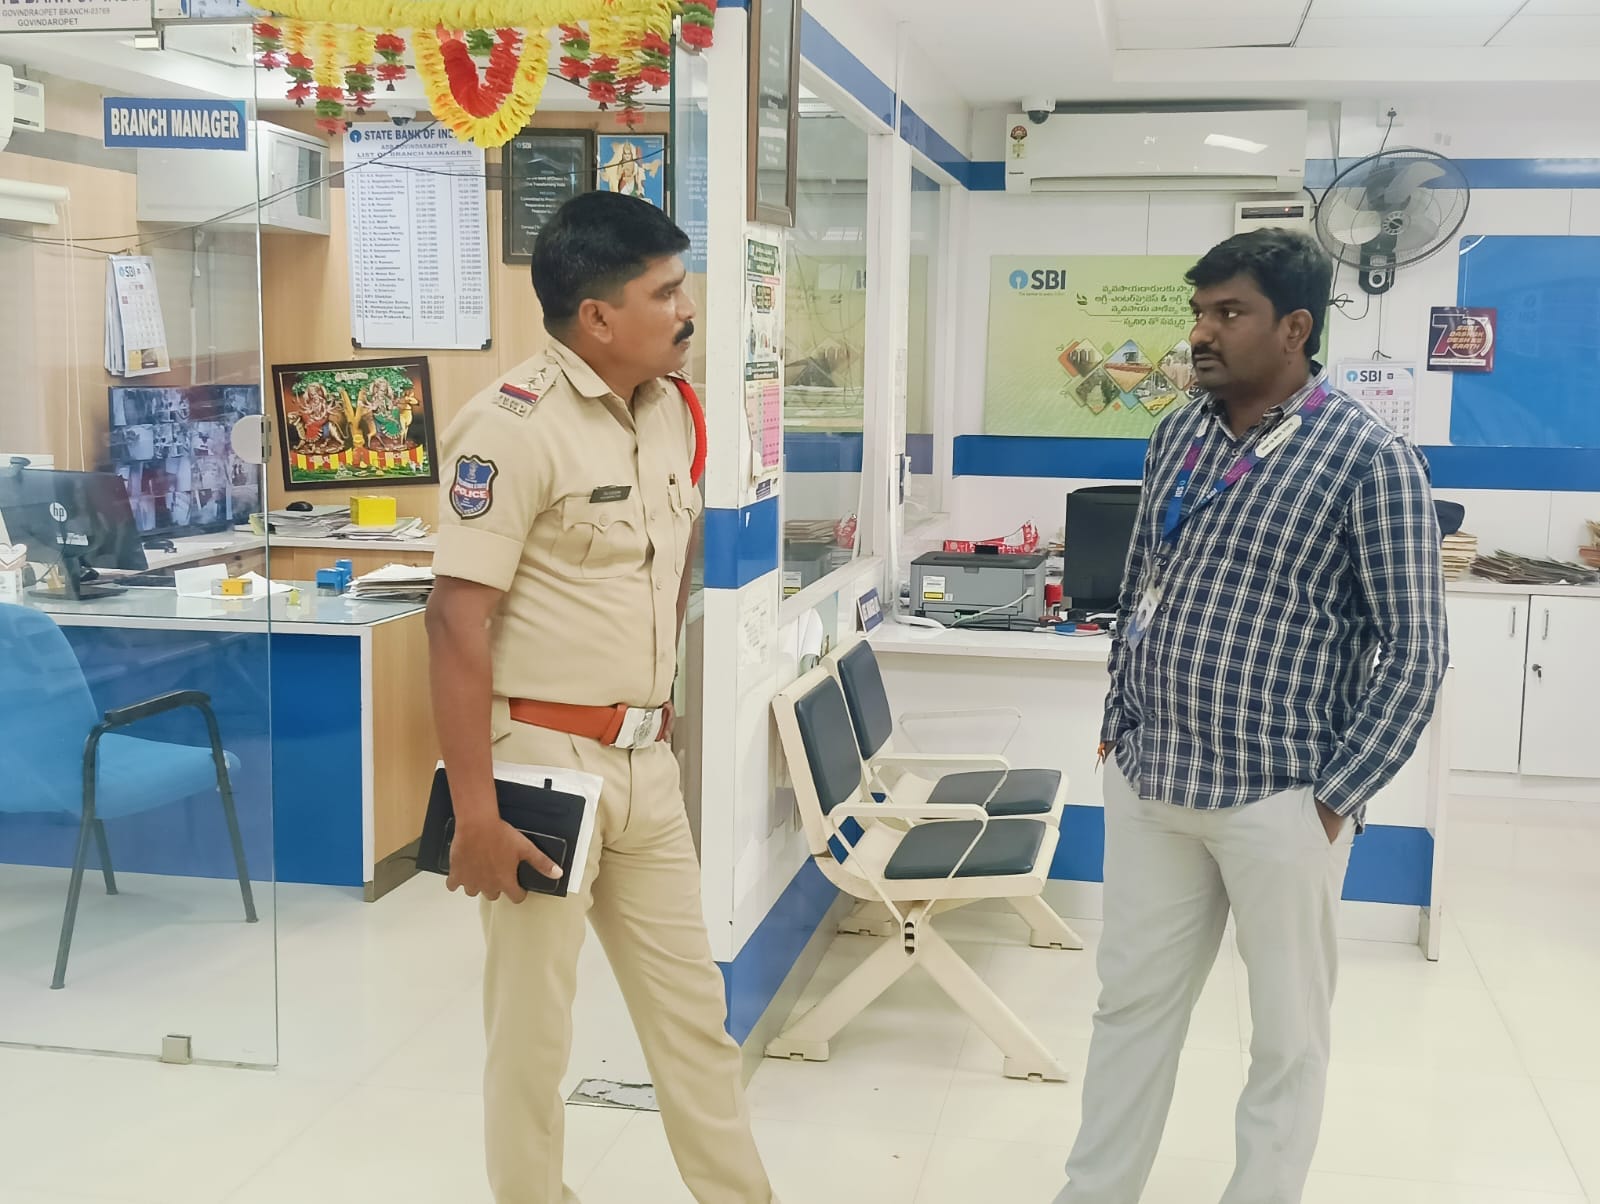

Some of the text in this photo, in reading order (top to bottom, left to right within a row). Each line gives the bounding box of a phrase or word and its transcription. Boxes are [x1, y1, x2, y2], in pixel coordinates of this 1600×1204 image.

[110, 108, 239, 139] BRANCH MANAGER
[364, 130, 393, 141] STATE
[395, 129, 420, 140] BANK
[422, 128, 436, 140] OF
[1031, 269, 1066, 290] SBI
[1359, 370, 1382, 382] SBI
[454, 484, 488, 499] POLICE
[53, 502, 65, 521] hp
